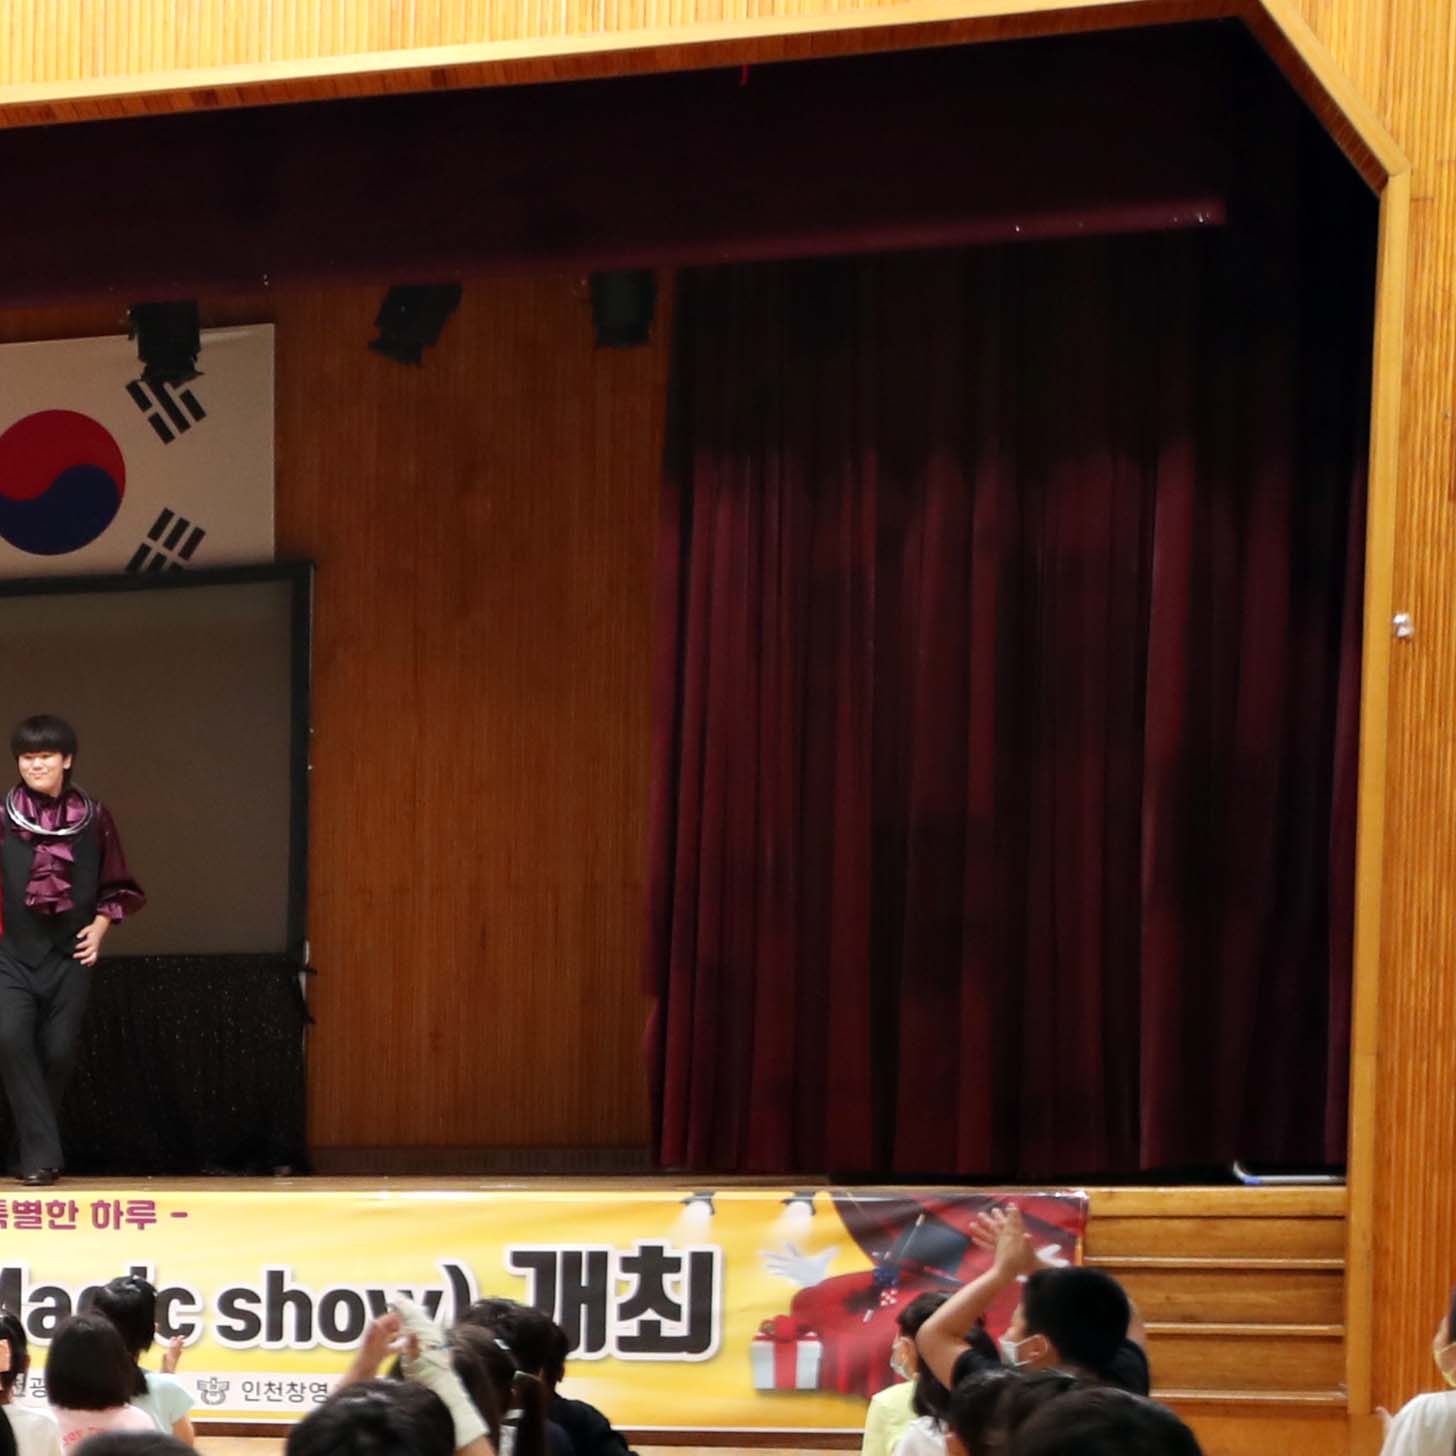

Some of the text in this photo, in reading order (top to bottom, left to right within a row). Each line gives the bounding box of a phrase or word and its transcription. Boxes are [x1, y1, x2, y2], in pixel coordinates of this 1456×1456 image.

[90, 1199, 157, 1231] 하루
[511, 1245, 714, 1354] 개최
[241, 1381, 329, 1404] 인천창영
